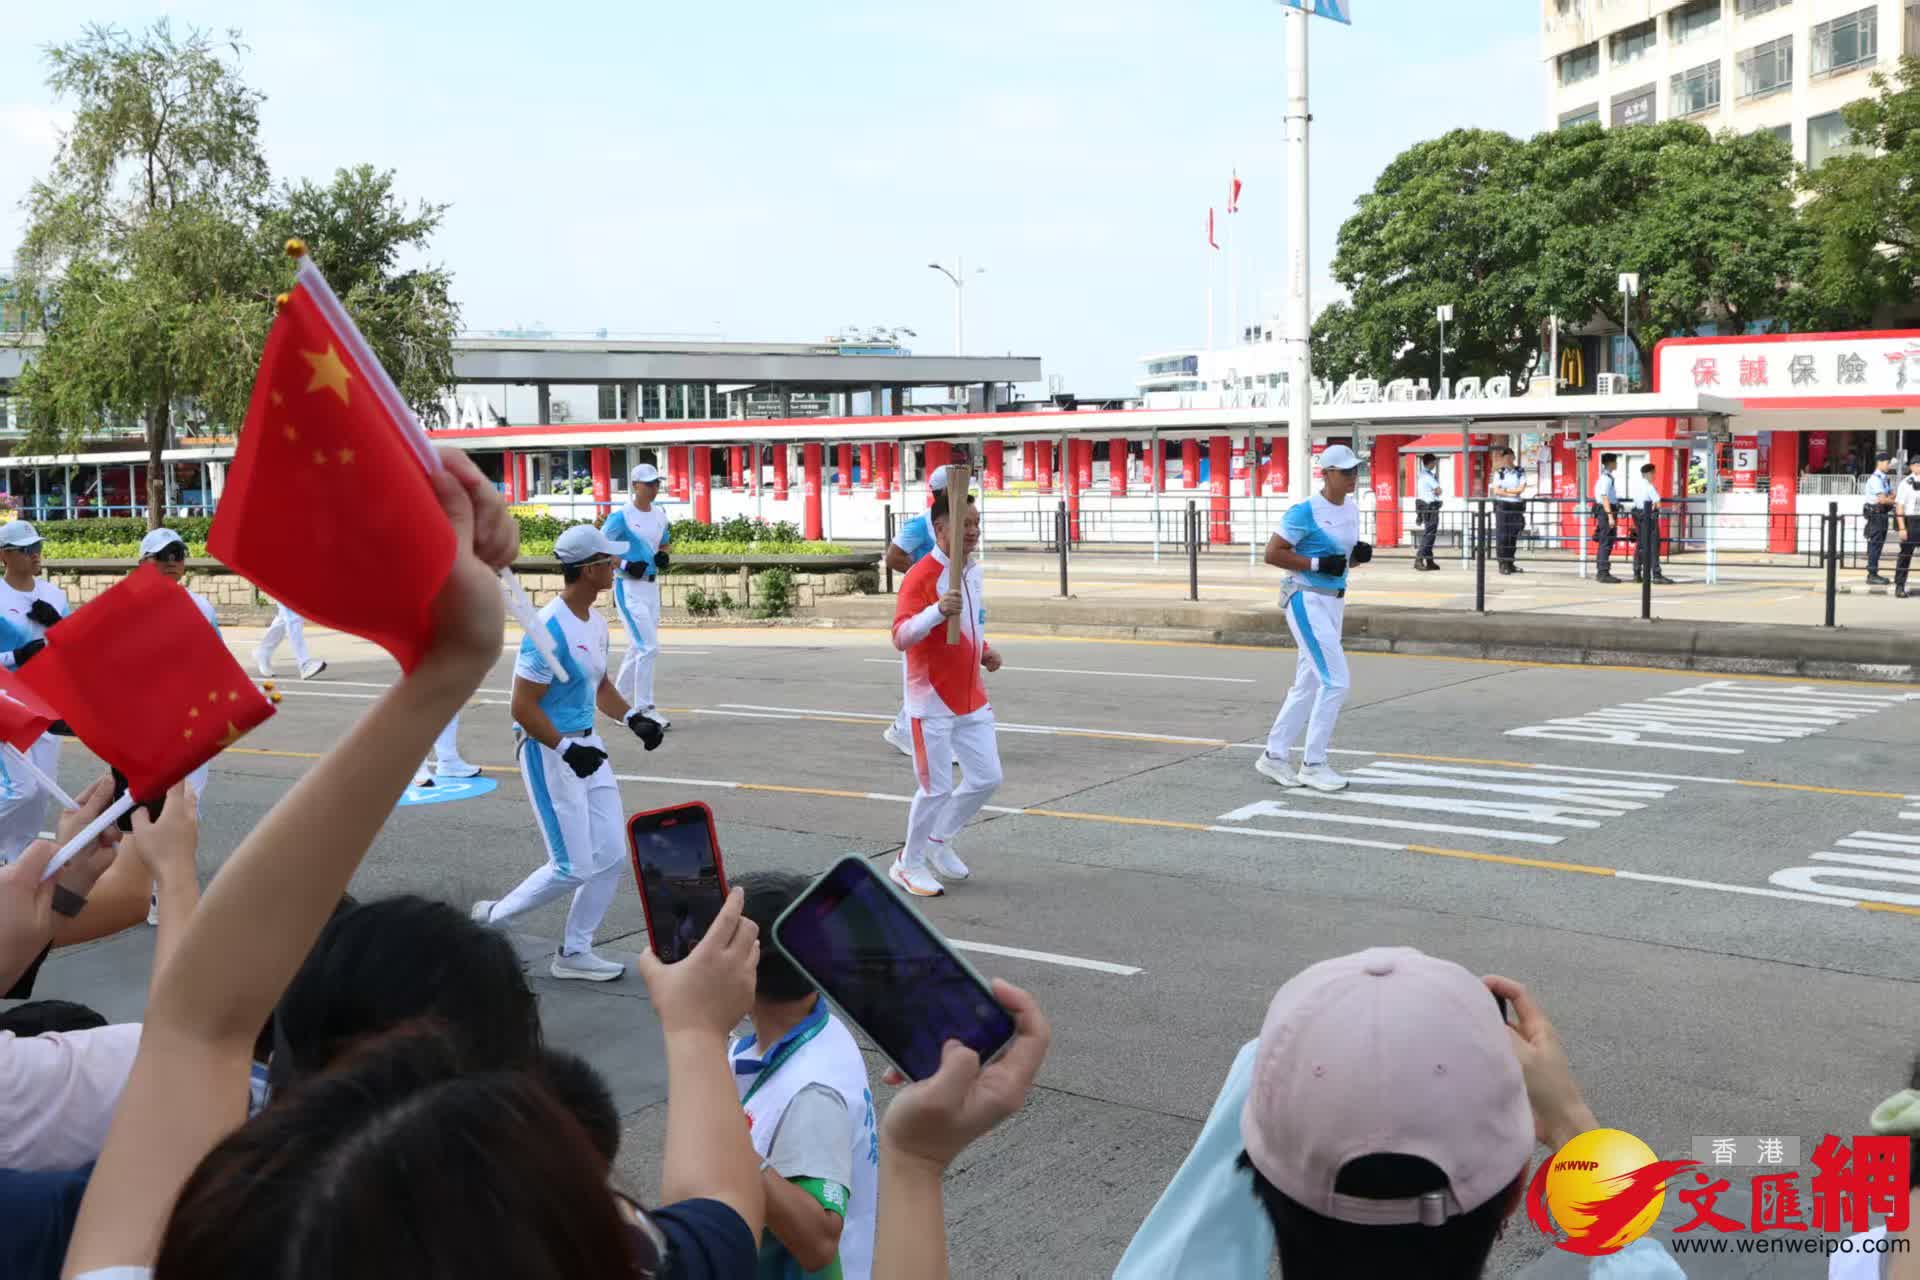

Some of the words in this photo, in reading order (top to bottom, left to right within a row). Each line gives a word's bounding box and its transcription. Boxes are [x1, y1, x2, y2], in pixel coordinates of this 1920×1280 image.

[1690, 351, 1868, 386] 保誠保險
[1737, 452, 1749, 467] 5
[1216, 760, 1680, 846] TAXI
